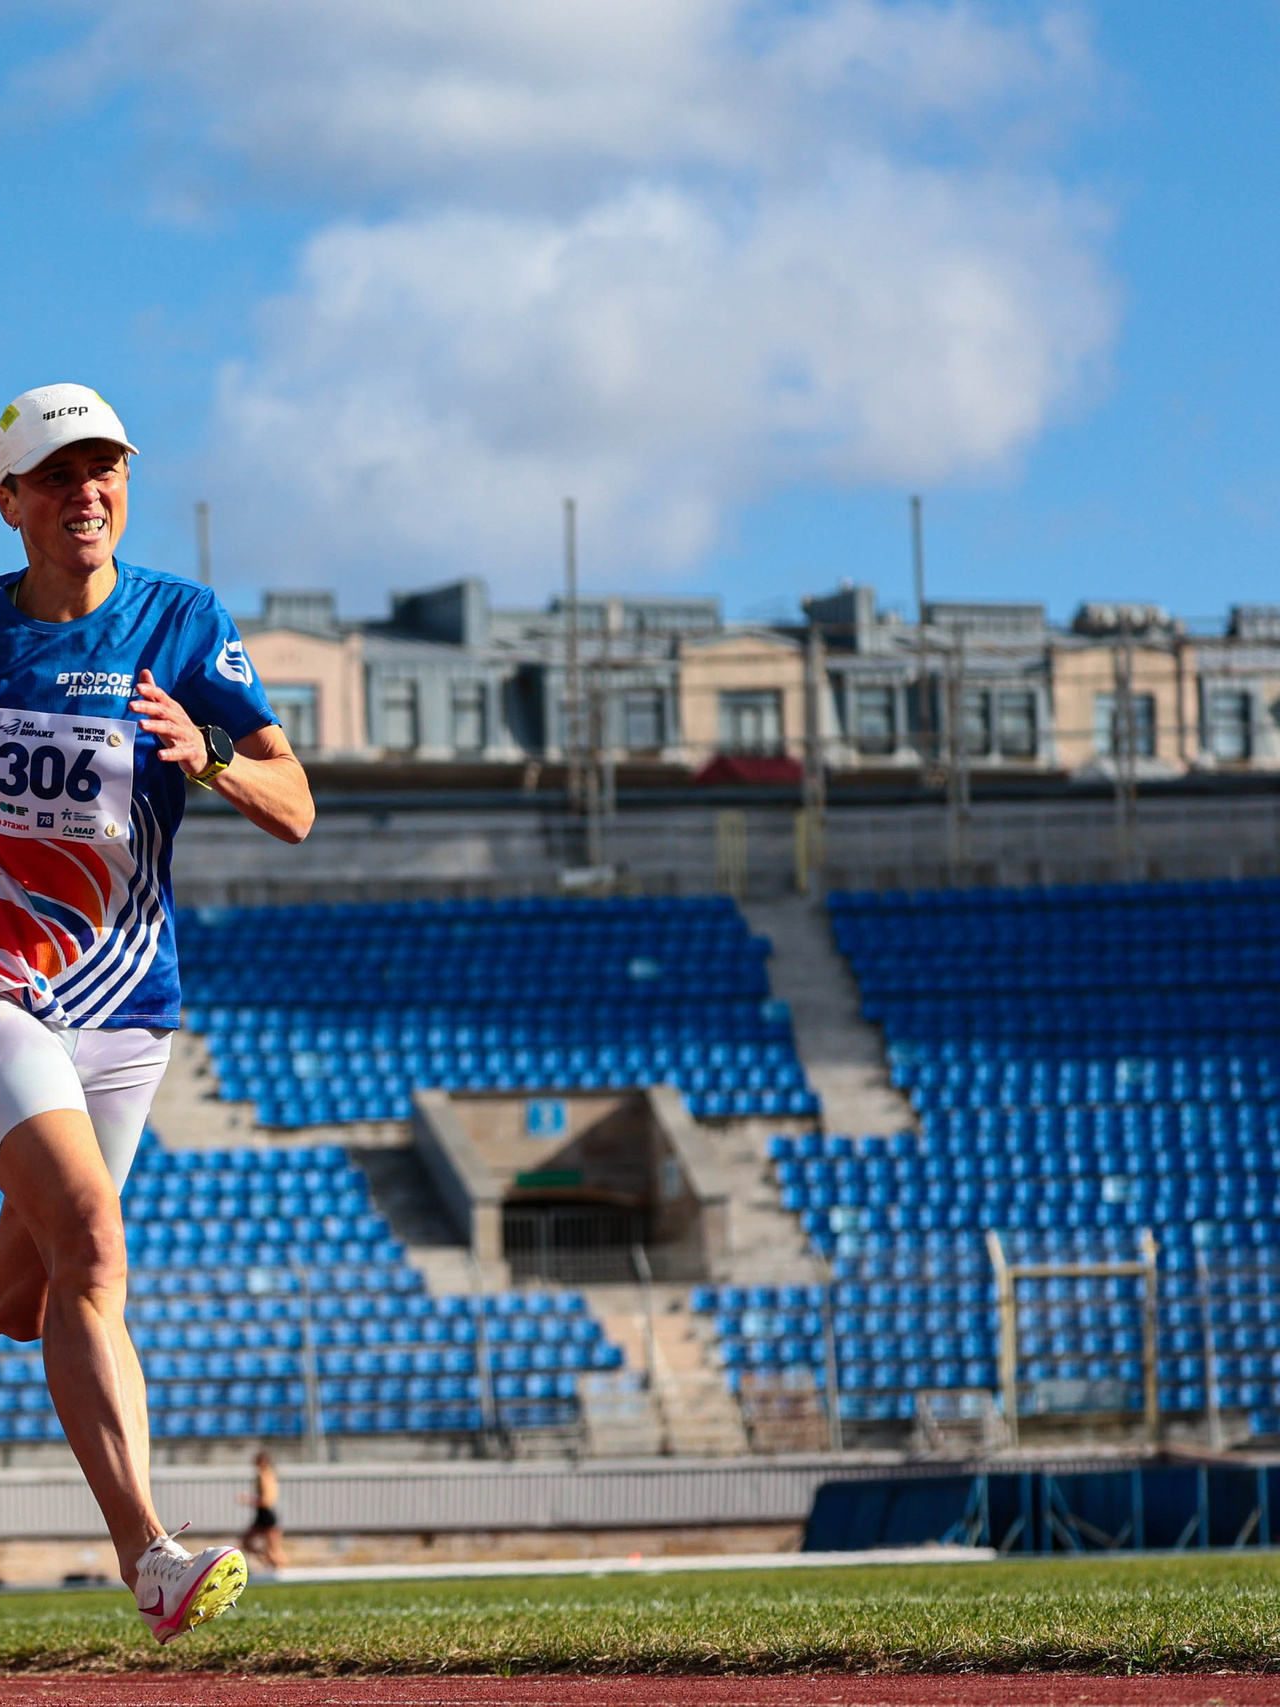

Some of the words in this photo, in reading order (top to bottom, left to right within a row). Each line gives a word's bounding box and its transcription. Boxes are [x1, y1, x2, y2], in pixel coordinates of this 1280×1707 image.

[57, 406, 89, 417] cep
[56, 671, 133, 687] ВТОРОЕ
[22, 721, 35, 729] НА
[19, 729, 55, 739] ВИРАЖЕ
[84, 727, 106, 736] МЕТРОВ
[39, 815, 52, 825] 78
